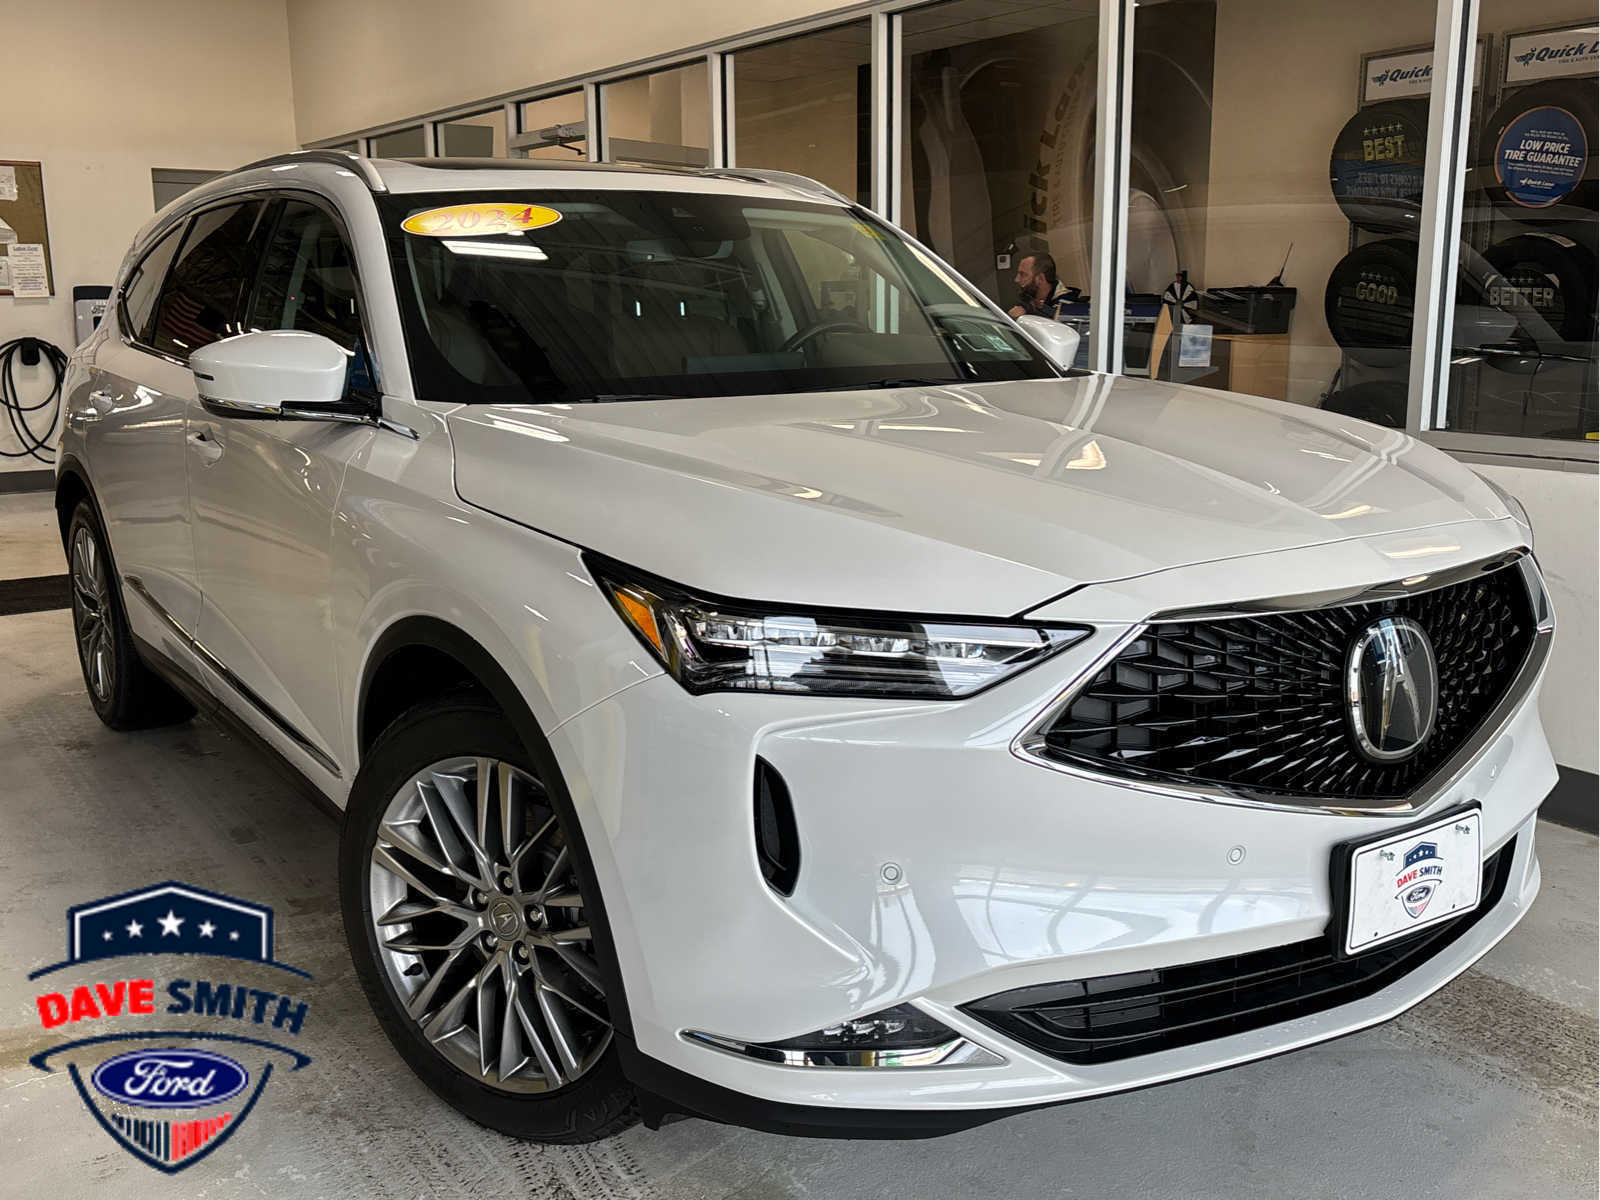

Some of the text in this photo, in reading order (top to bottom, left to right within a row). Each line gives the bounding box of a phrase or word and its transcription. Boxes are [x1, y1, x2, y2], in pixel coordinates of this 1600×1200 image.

[1535, 43, 1587, 62] Quick
[1389, 65, 1433, 82] Quick
[1362, 134, 1405, 162] BEST
[1520, 139, 1571, 154] LOW PRICE
[1504, 149, 1527, 161] TIRE
[1526, 152, 1583, 168] GUARANTEE
[432, 207, 533, 232] 2024
[1356, 281, 1398, 305] GOOD
[1489, 286, 1554, 308] BETTER
[1397, 866, 1442, 888] DAVE SMITH
